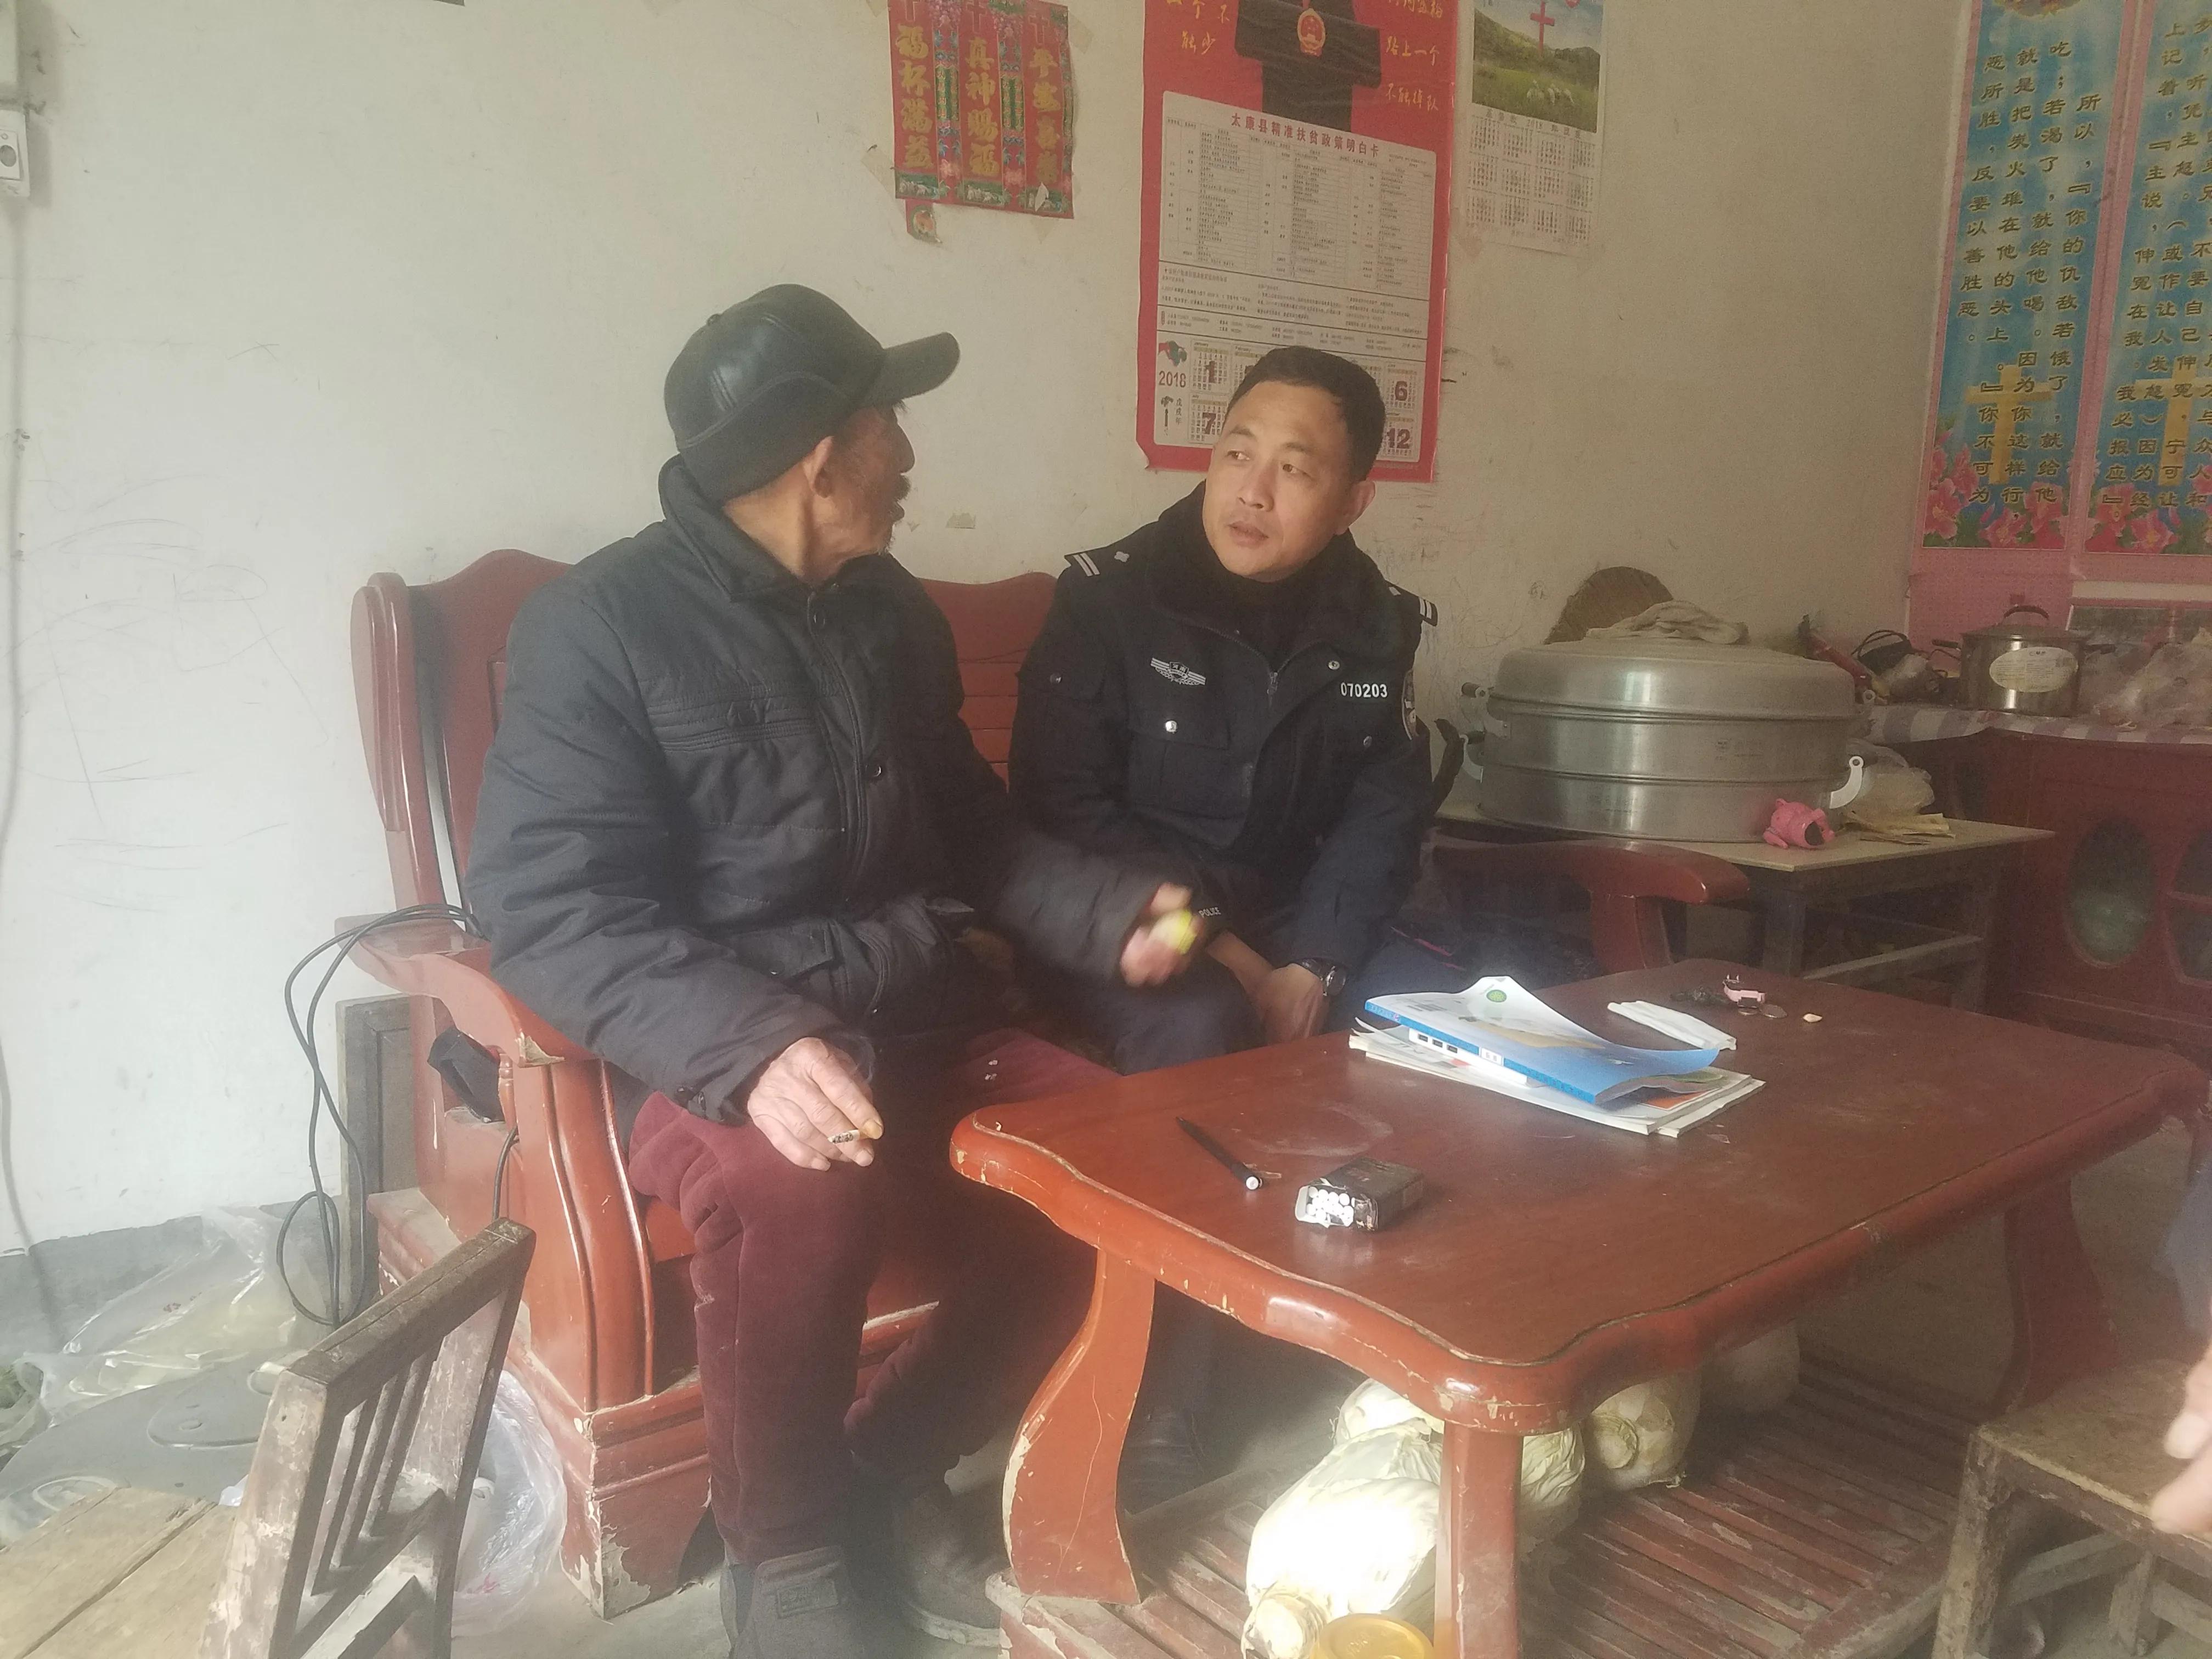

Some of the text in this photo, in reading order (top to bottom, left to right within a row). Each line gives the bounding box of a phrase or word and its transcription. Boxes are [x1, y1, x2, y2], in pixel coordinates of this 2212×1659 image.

[1231, 112, 1379, 159] 太康县精准扶贫政策明白卡
[1159, 370, 1187, 388] 2018
[1395, 380, 1408, 402] 6
[1202, 411, 1217, 435] 7
[1386, 427, 1410, 449] 12
[1341, 682, 1388, 698] 070203
[1198, 907, 1221, 918] POLICE
